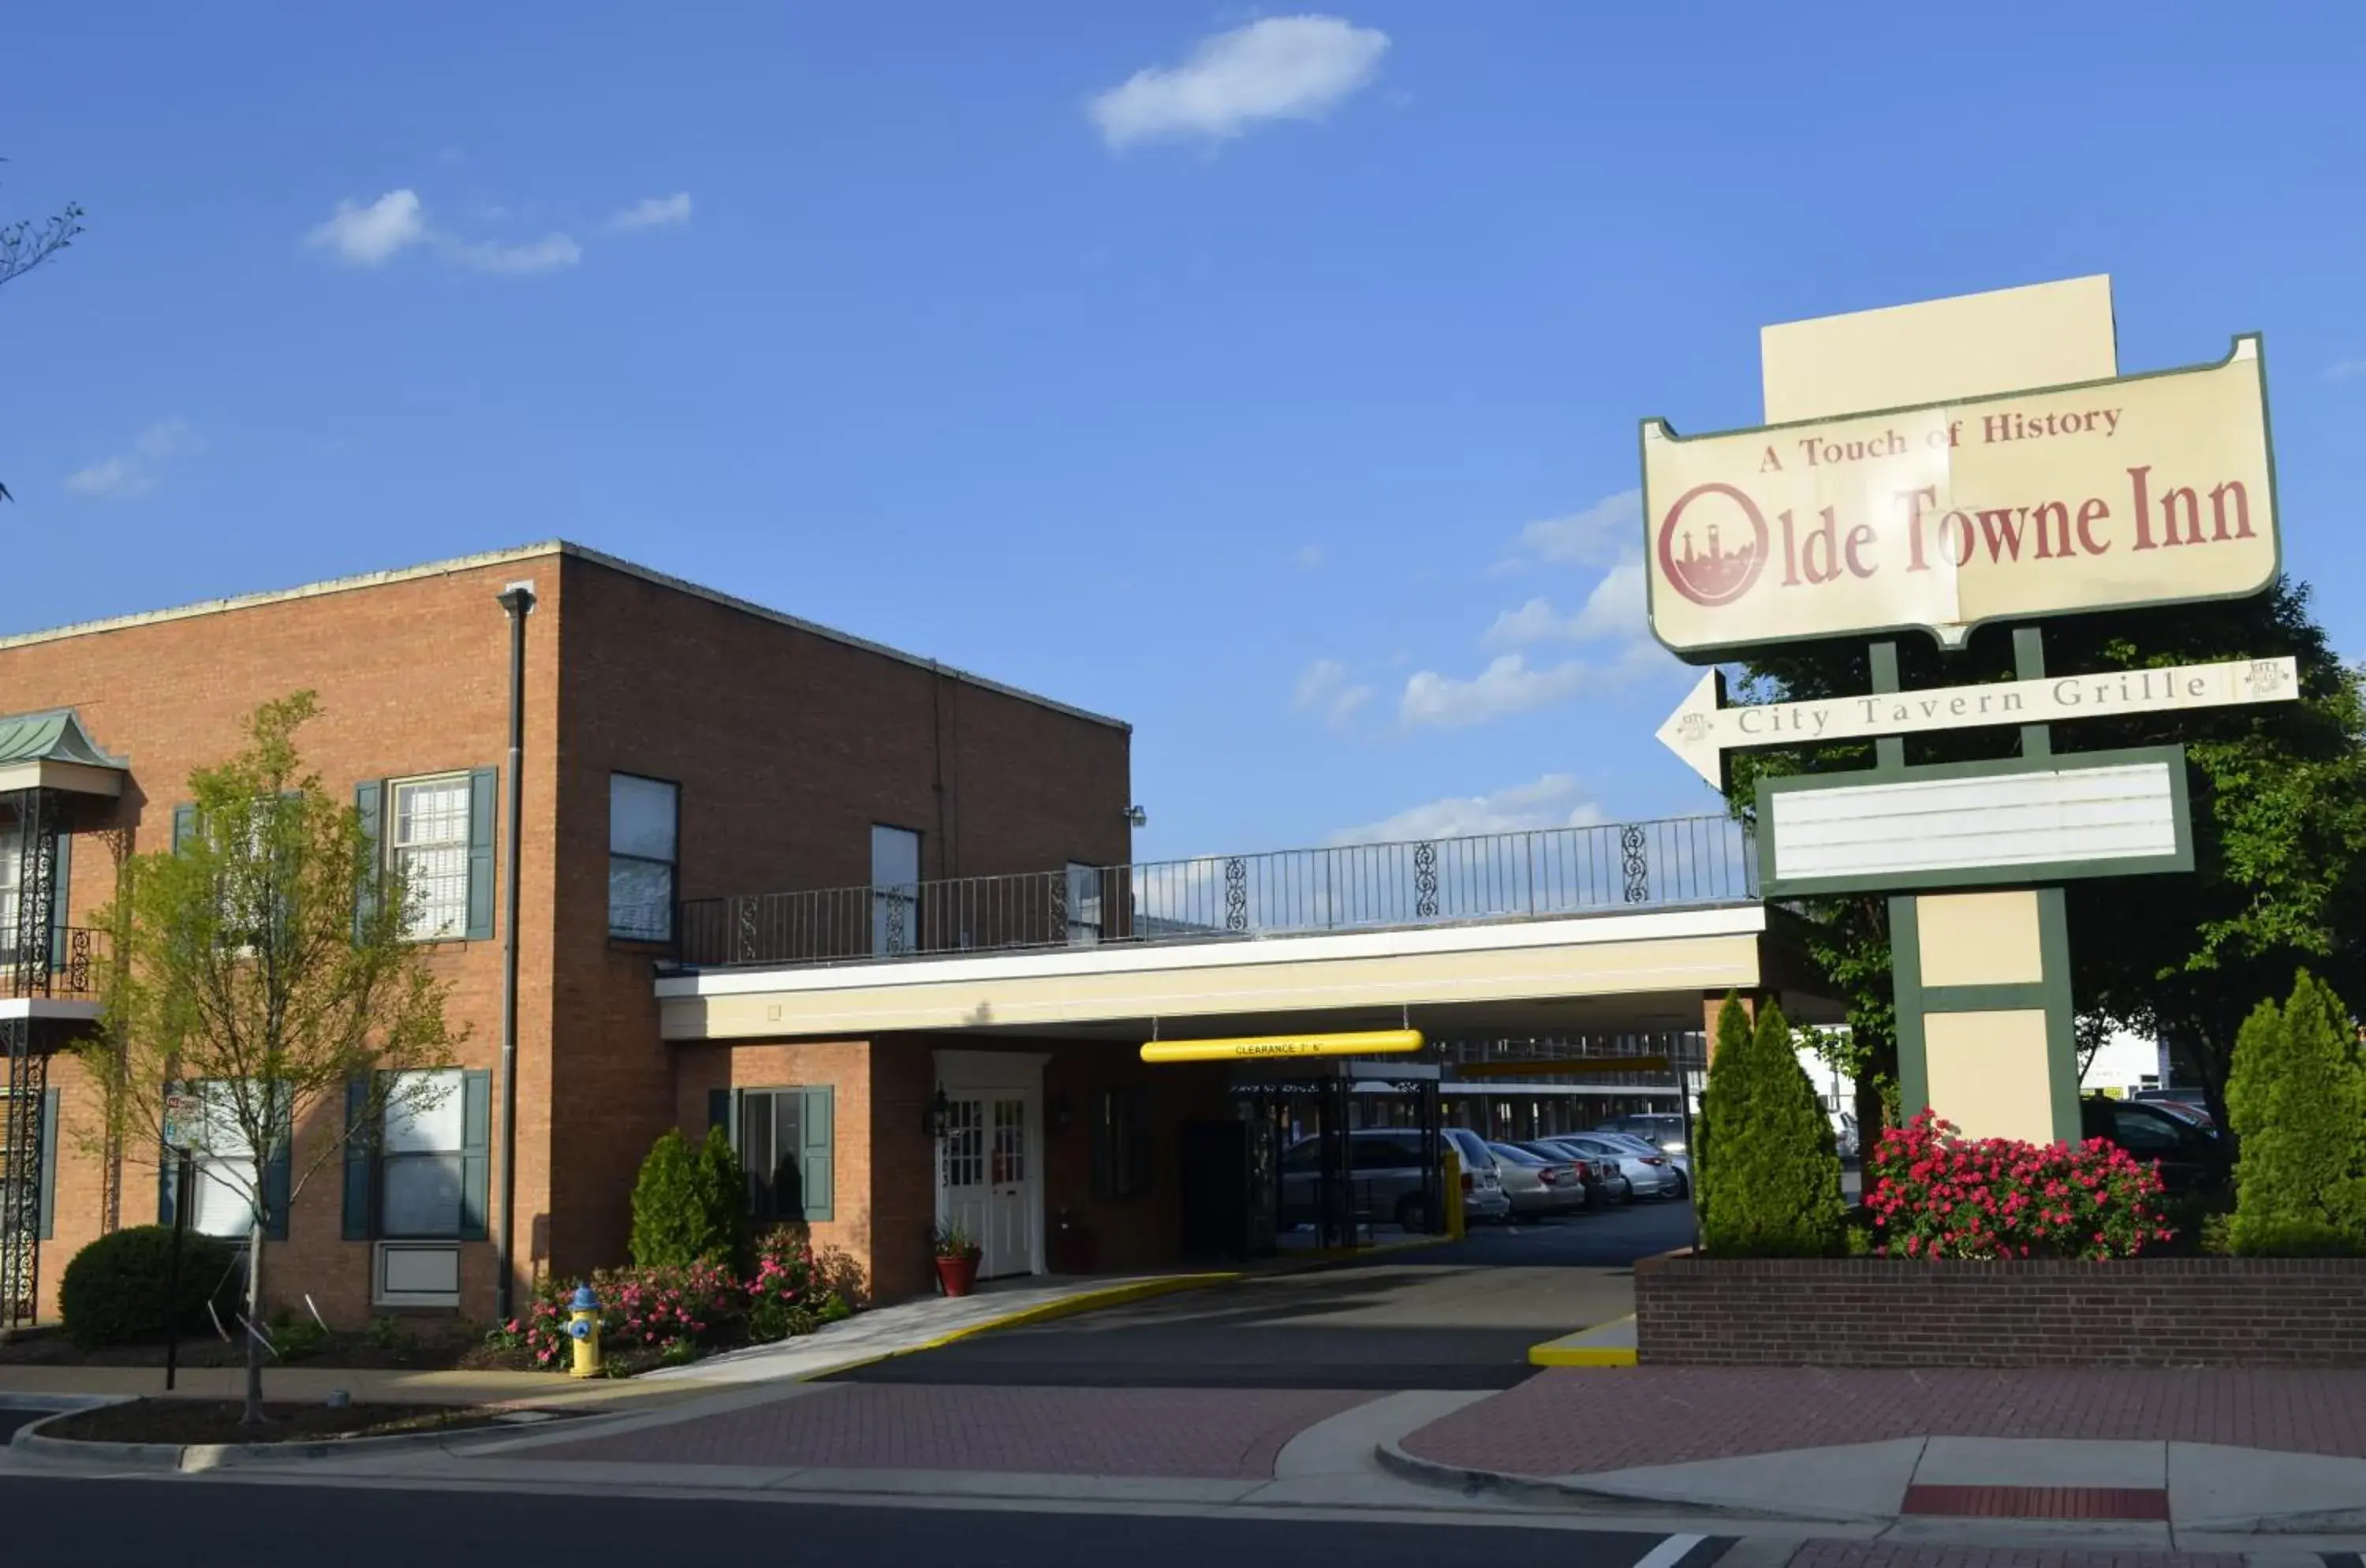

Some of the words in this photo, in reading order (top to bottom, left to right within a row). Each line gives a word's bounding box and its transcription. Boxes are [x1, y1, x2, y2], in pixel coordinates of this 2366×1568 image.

[1759, 444, 1785, 473] A
[1799, 428, 1907, 469] Touch
[1928, 420, 1964, 450] of
[1982, 404, 2125, 446] History
[1658, 482, 1880, 607] Olde
[1894, 483, 2112, 573] Towne
[2125, 464, 2257, 552] Inn
[1738, 706, 1830, 737] City
[1858, 689, 2024, 723] Tavern
[2053, 672, 2206, 705] Grille
[1235, 1043, 1297, 1055] CLEARANCE
